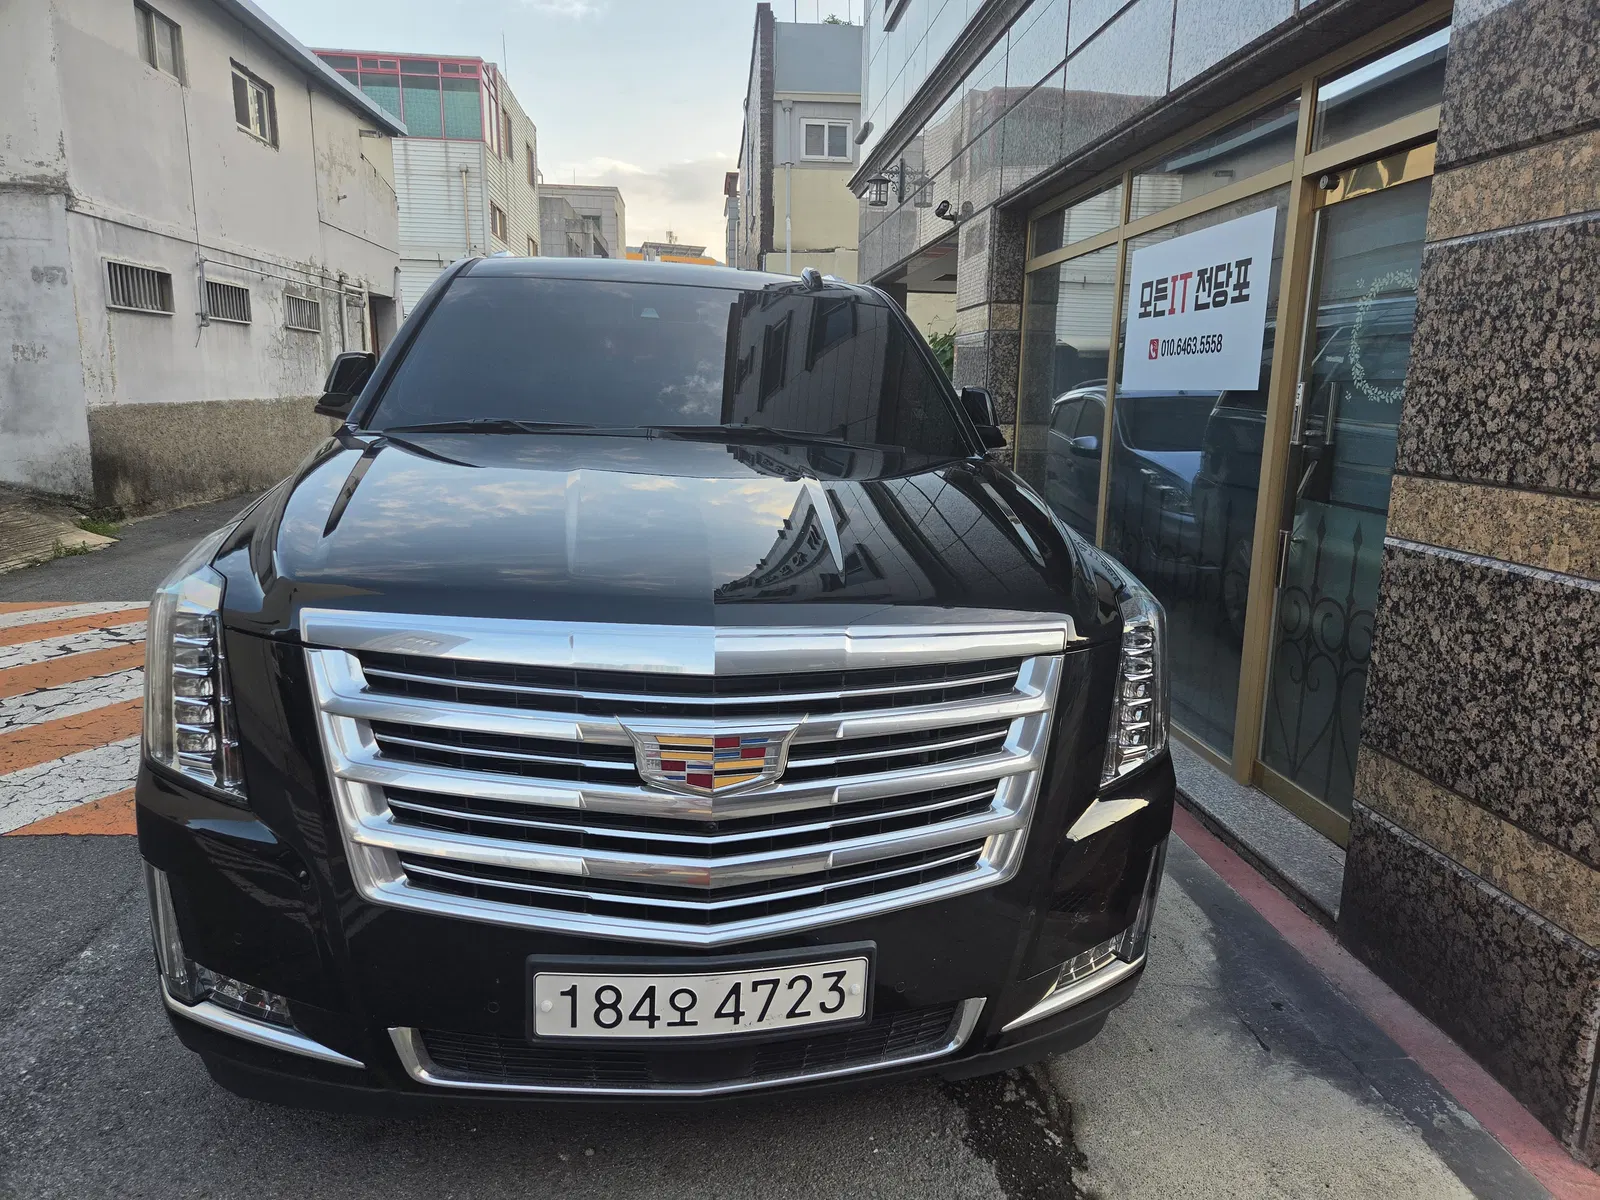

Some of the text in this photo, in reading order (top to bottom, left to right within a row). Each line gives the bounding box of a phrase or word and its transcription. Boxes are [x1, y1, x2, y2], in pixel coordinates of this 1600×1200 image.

[1194, 257, 1253, 312] 전당포
[1160, 334, 1223, 357] 010.6463.5558
[559, 970, 847, 1029] 184오 4723
